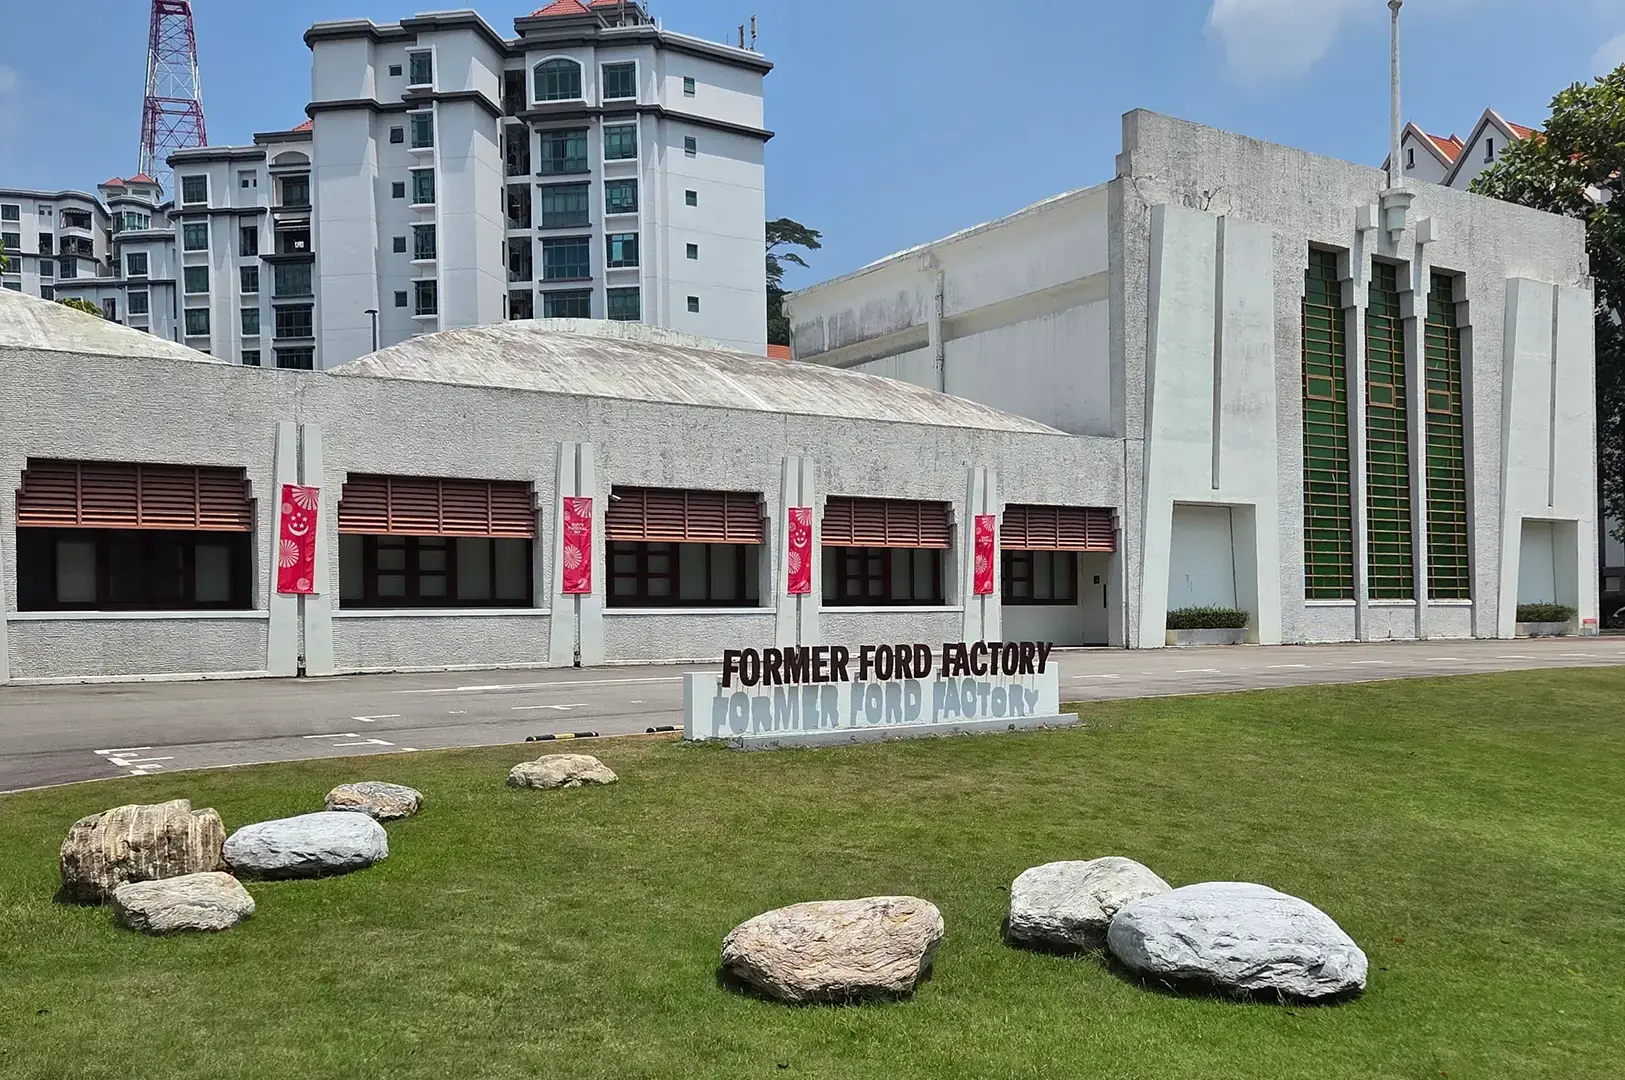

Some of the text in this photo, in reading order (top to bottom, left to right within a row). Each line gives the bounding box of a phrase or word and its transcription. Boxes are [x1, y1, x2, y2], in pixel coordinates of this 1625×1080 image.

[722, 641, 1053, 688] FORMER FORD FACTORY
